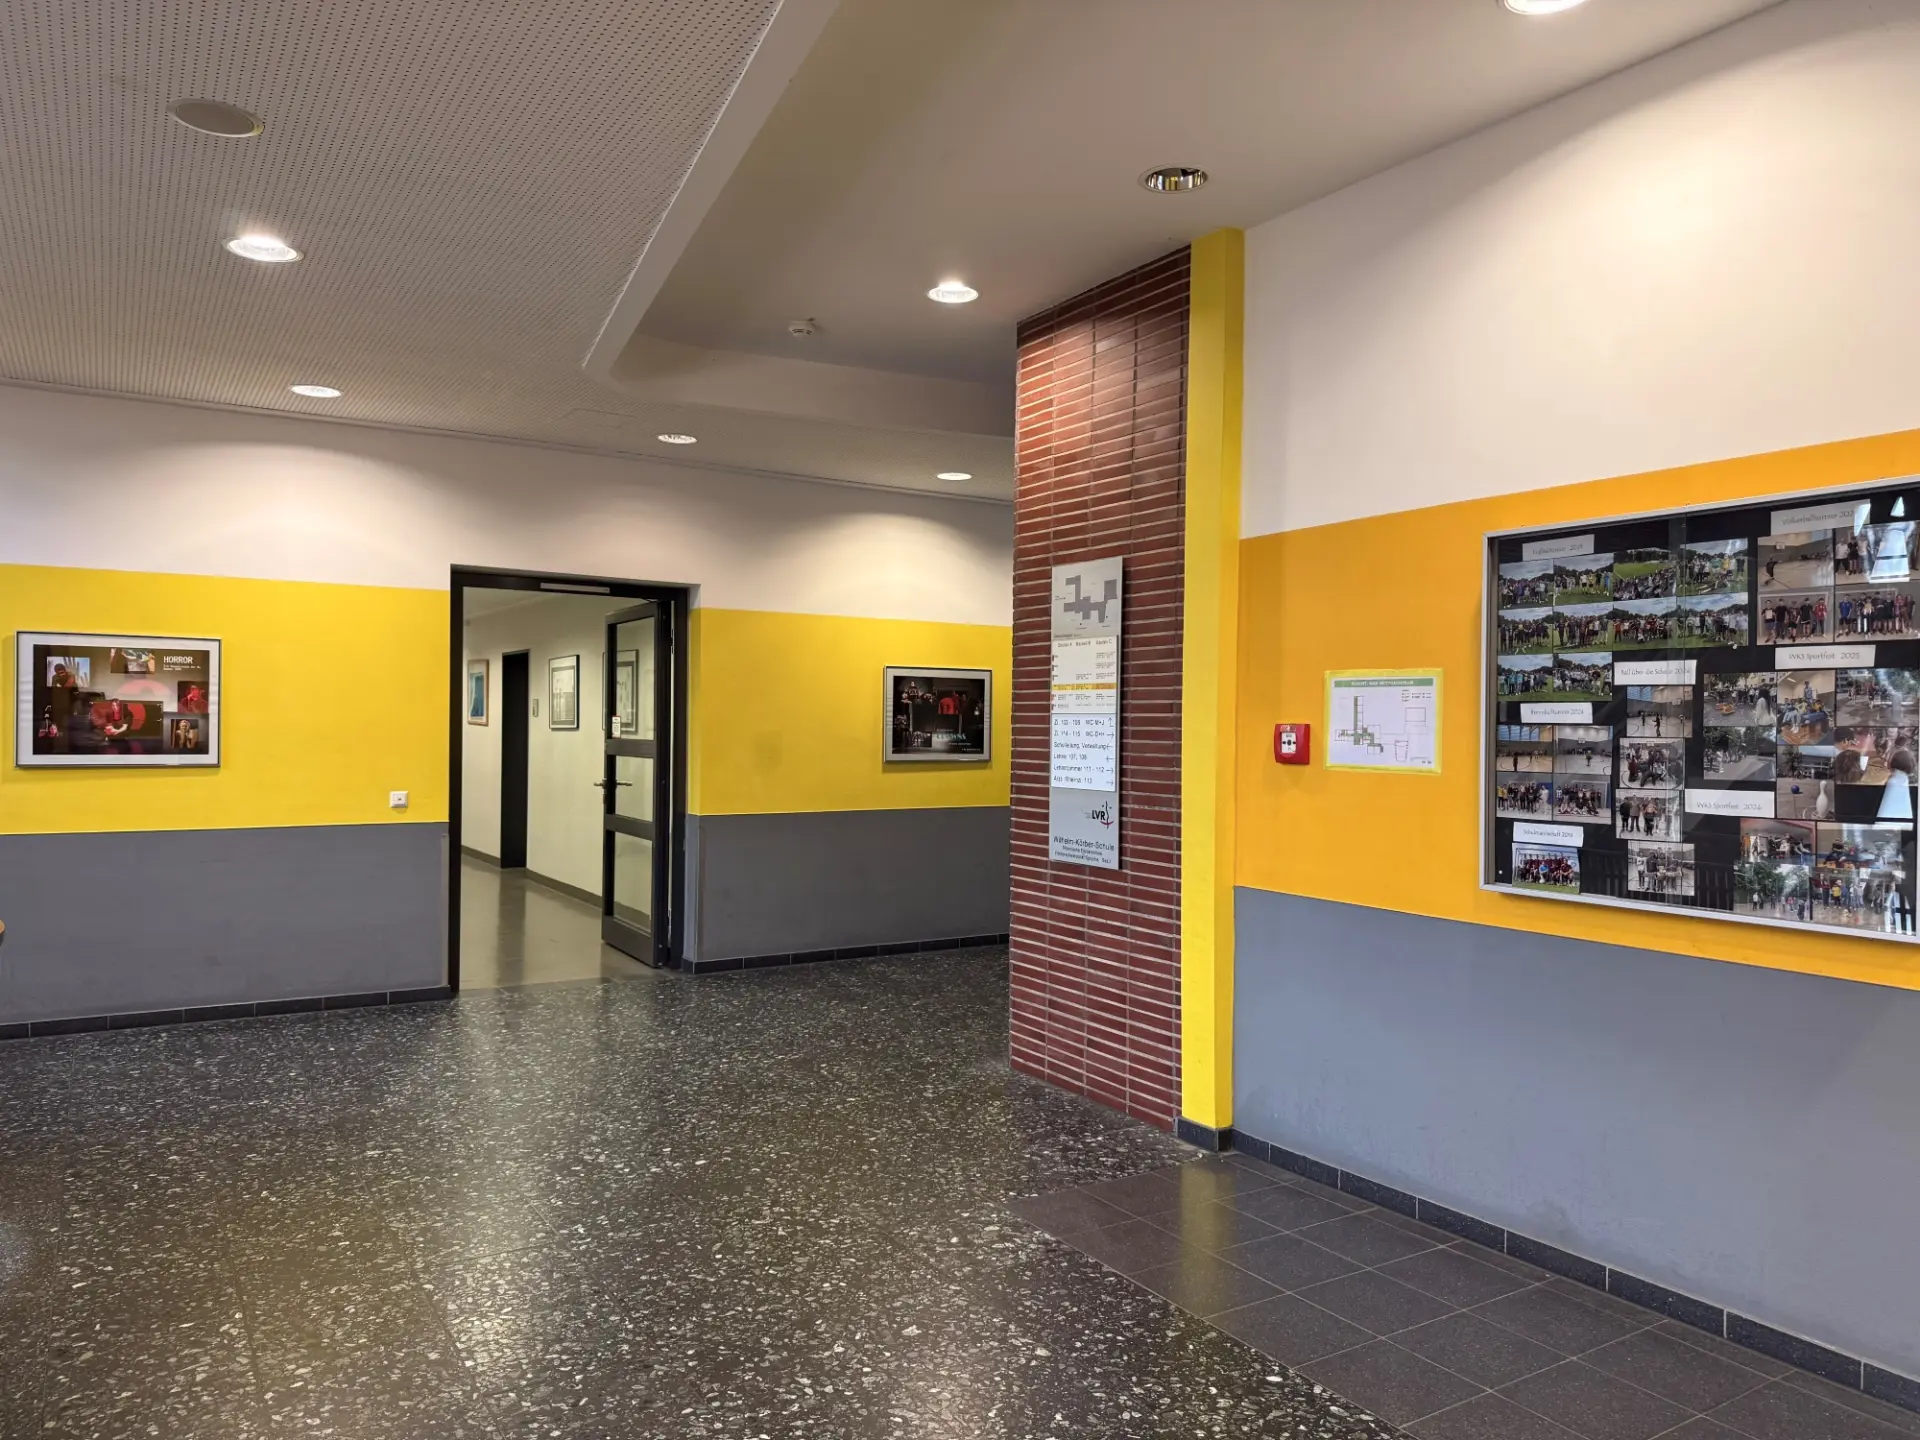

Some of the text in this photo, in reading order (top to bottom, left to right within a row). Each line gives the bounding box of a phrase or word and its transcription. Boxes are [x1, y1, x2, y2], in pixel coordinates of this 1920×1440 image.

[163, 655, 193, 664] HORROR
[1806, 652, 1835, 661] Sportfest
[1840, 652, 1860, 660] 2025
[1713, 801, 1739, 810] Sportfest
[1091, 810, 1106, 821] LVR
